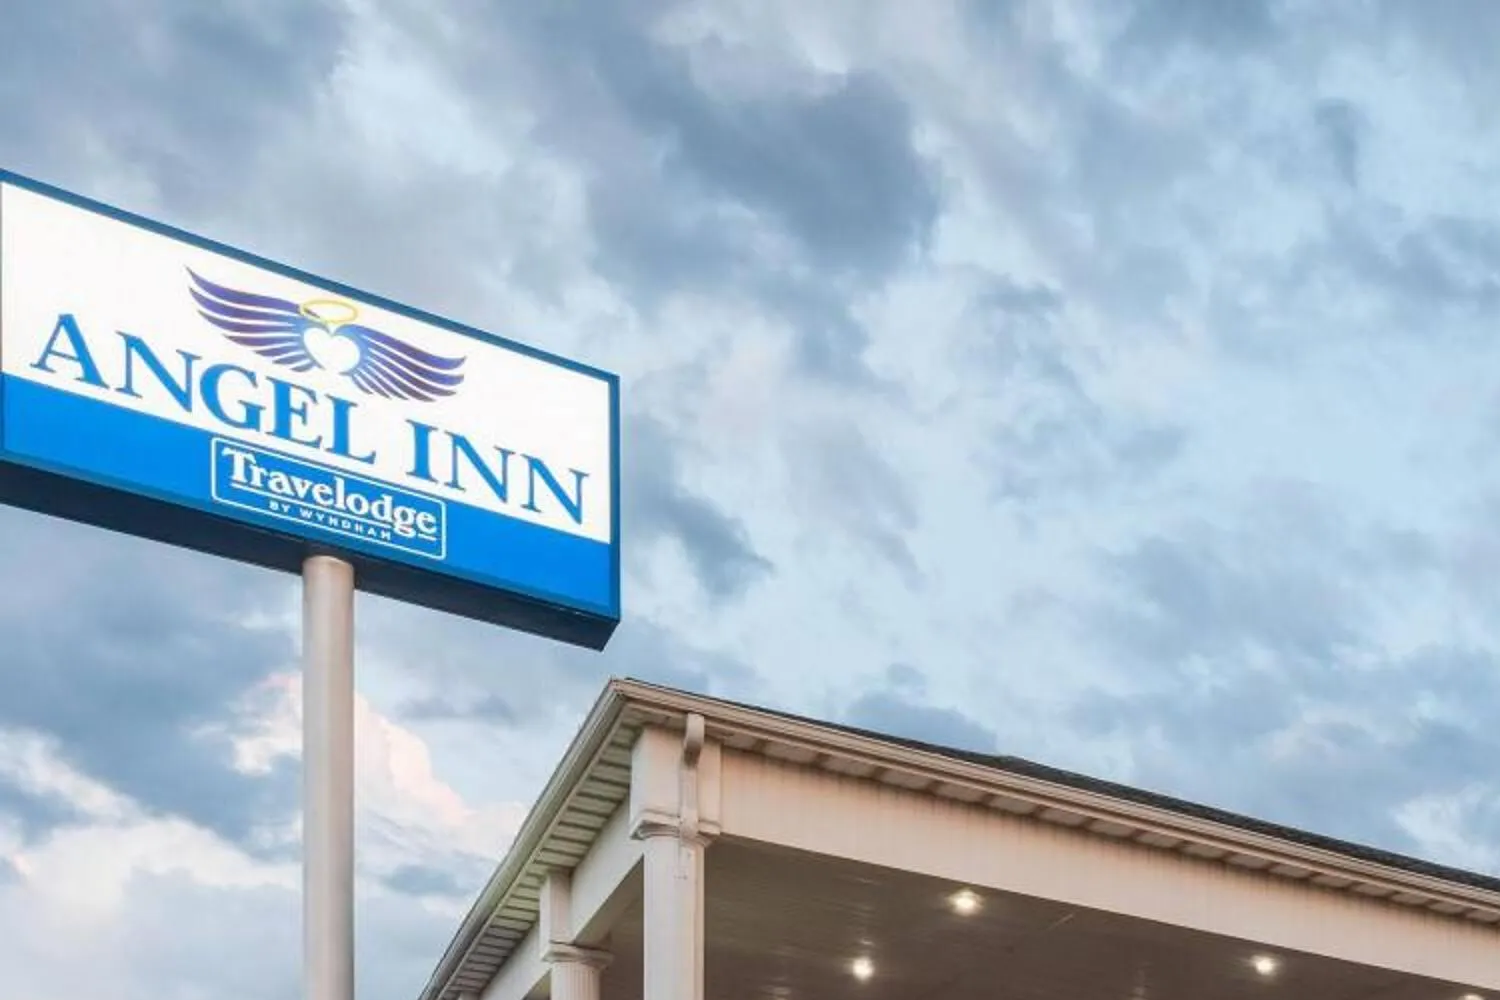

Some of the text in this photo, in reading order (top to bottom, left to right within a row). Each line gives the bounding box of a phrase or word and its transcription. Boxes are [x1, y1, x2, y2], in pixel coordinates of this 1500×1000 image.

[30, 313, 590, 526] ANGEL INN
[221, 447, 438, 537] Travelodge
[268, 500, 393, 542] BY WYNDHAM
